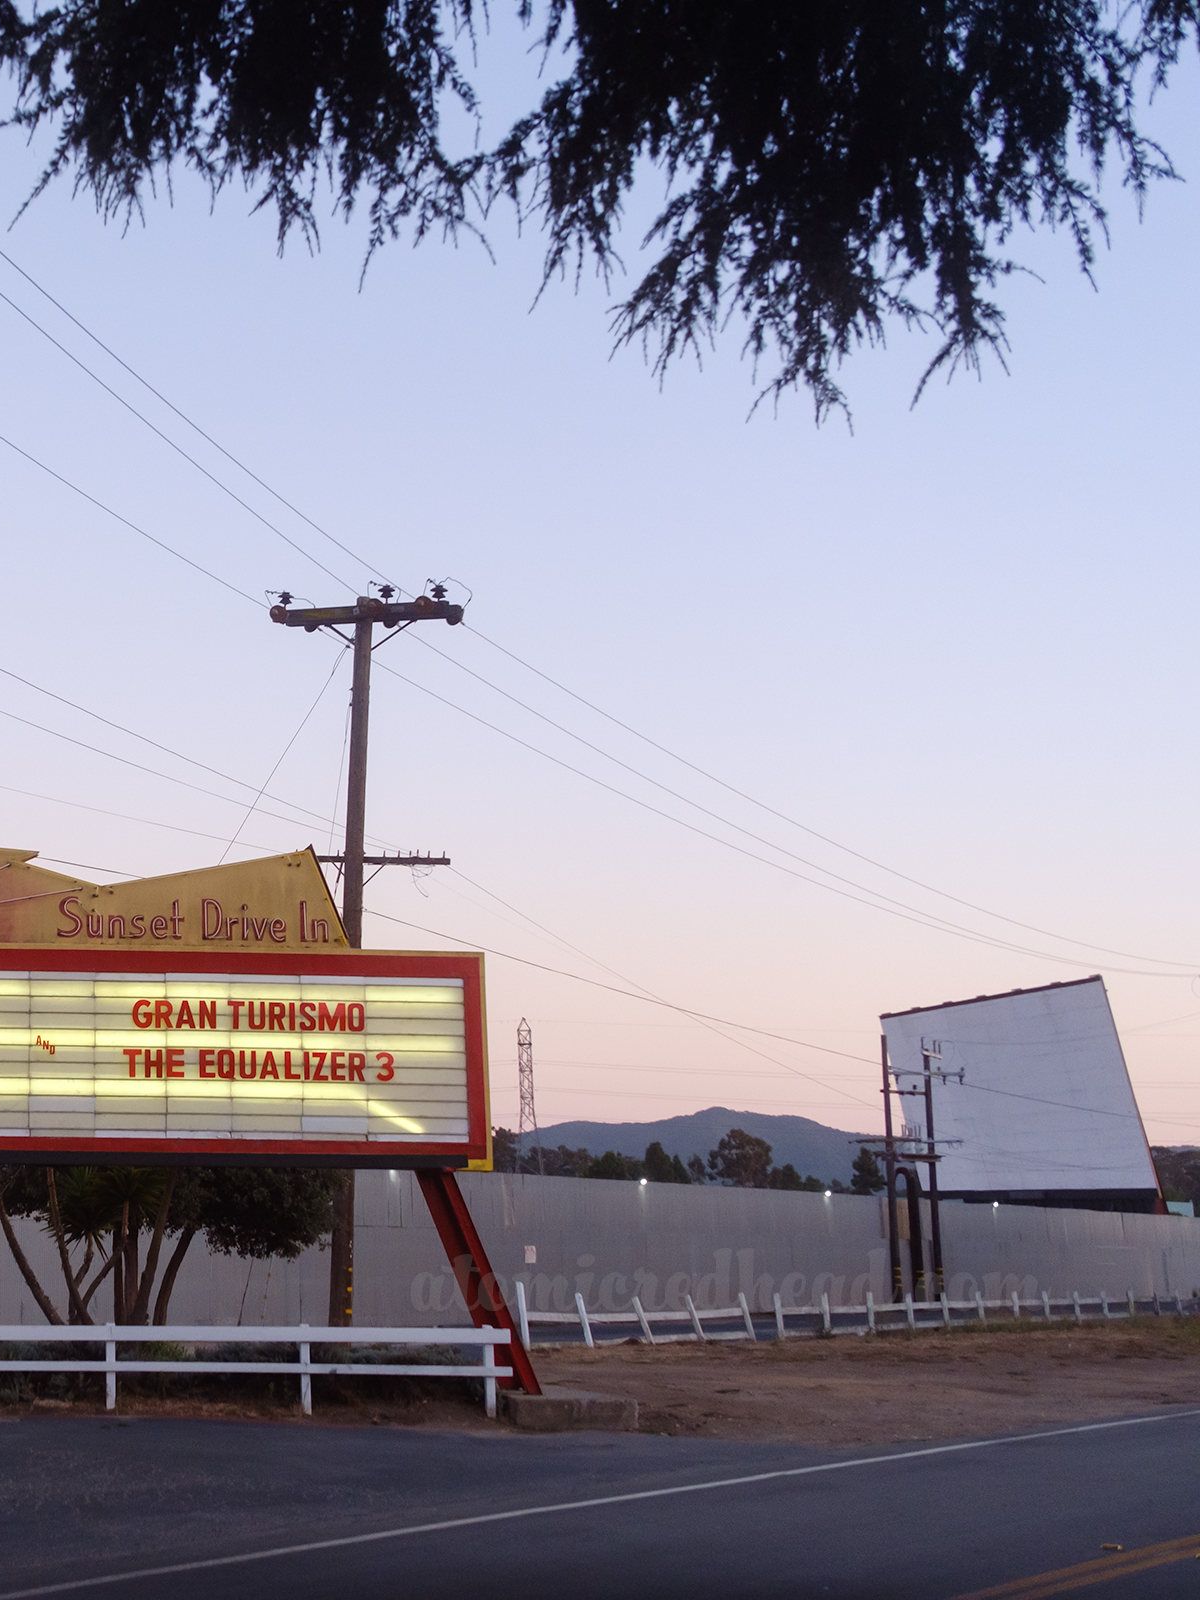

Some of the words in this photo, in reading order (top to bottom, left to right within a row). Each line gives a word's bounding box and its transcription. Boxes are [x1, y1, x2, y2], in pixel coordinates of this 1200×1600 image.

[57, 896, 185, 940] Sunset
[201, 898, 287, 943] Drive
[300, 901, 329, 943] In
[132, 999, 216, 1029] GRAN
[227, 1001, 365, 1032] TURISMO
[36, 1035, 55, 1055] AND
[123, 1049, 185, 1078] THE
[200, 1049, 366, 1081] EQUALIZER
[376, 1052, 395, 1082] 3
